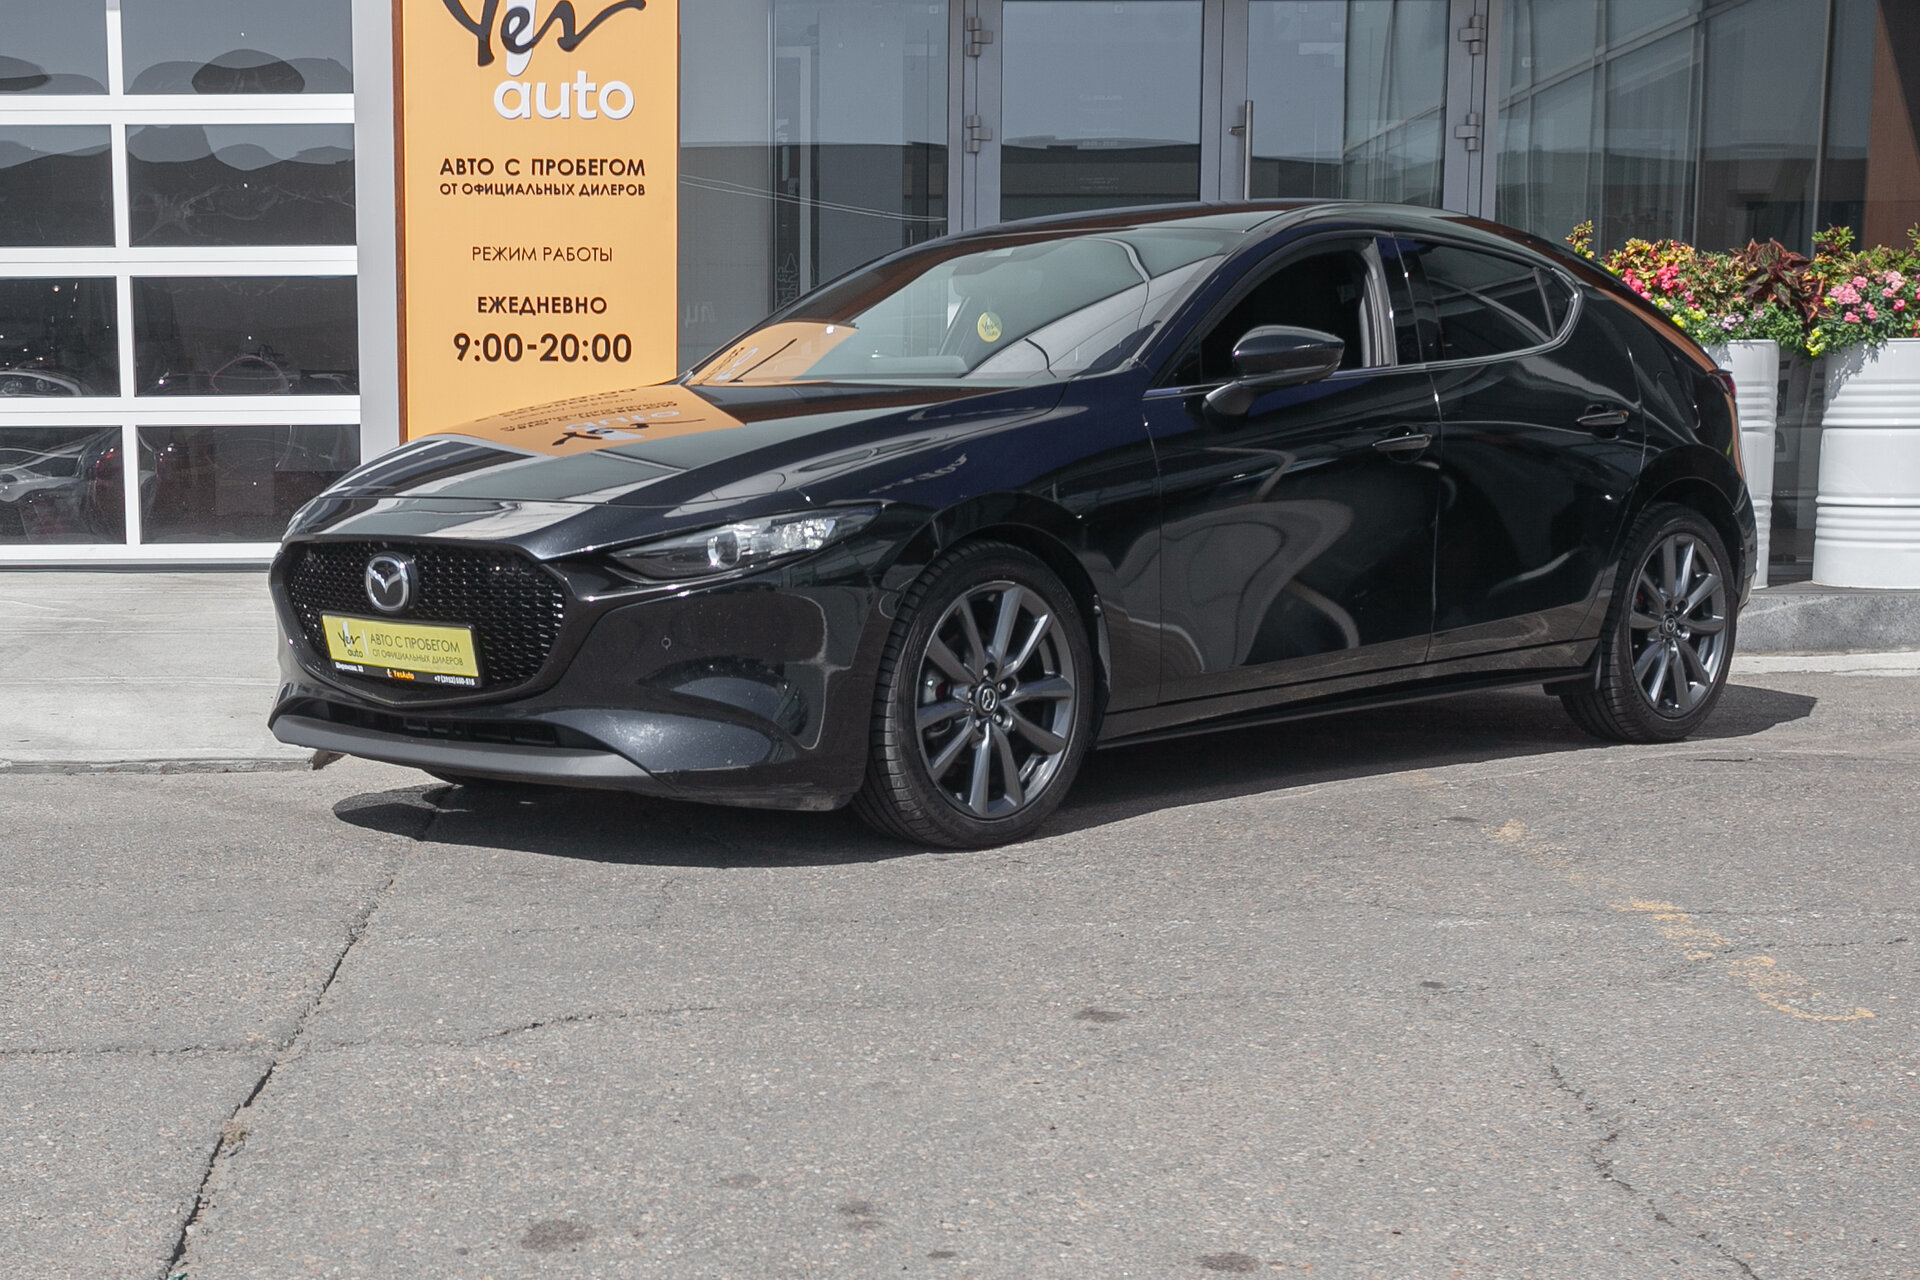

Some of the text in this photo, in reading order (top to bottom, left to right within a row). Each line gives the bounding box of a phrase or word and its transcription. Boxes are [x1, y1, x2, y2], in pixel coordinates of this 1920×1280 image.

[493, 69, 635, 120] auto
[440, 158, 646, 176] АВТО С ПРОБЕГОМ
[440, 183, 646, 197] ОТ ОФИЦИАЛЬНЫХ ДИЛЕРОВ
[472, 246, 613, 262] РЕЖИМ РАБОТЫ
[477, 296, 608, 316] ЕЖЕДНЕВНО
[453, 332, 632, 363] 9:00-20:00
[370, 633, 461, 653] АВТО С ПРОБЕГОМ
[347, 649, 364, 658] auto
[372, 648, 464, 666] ОТ ОФИЦИАЛЬНЫХ ДИЛЕРОВ
